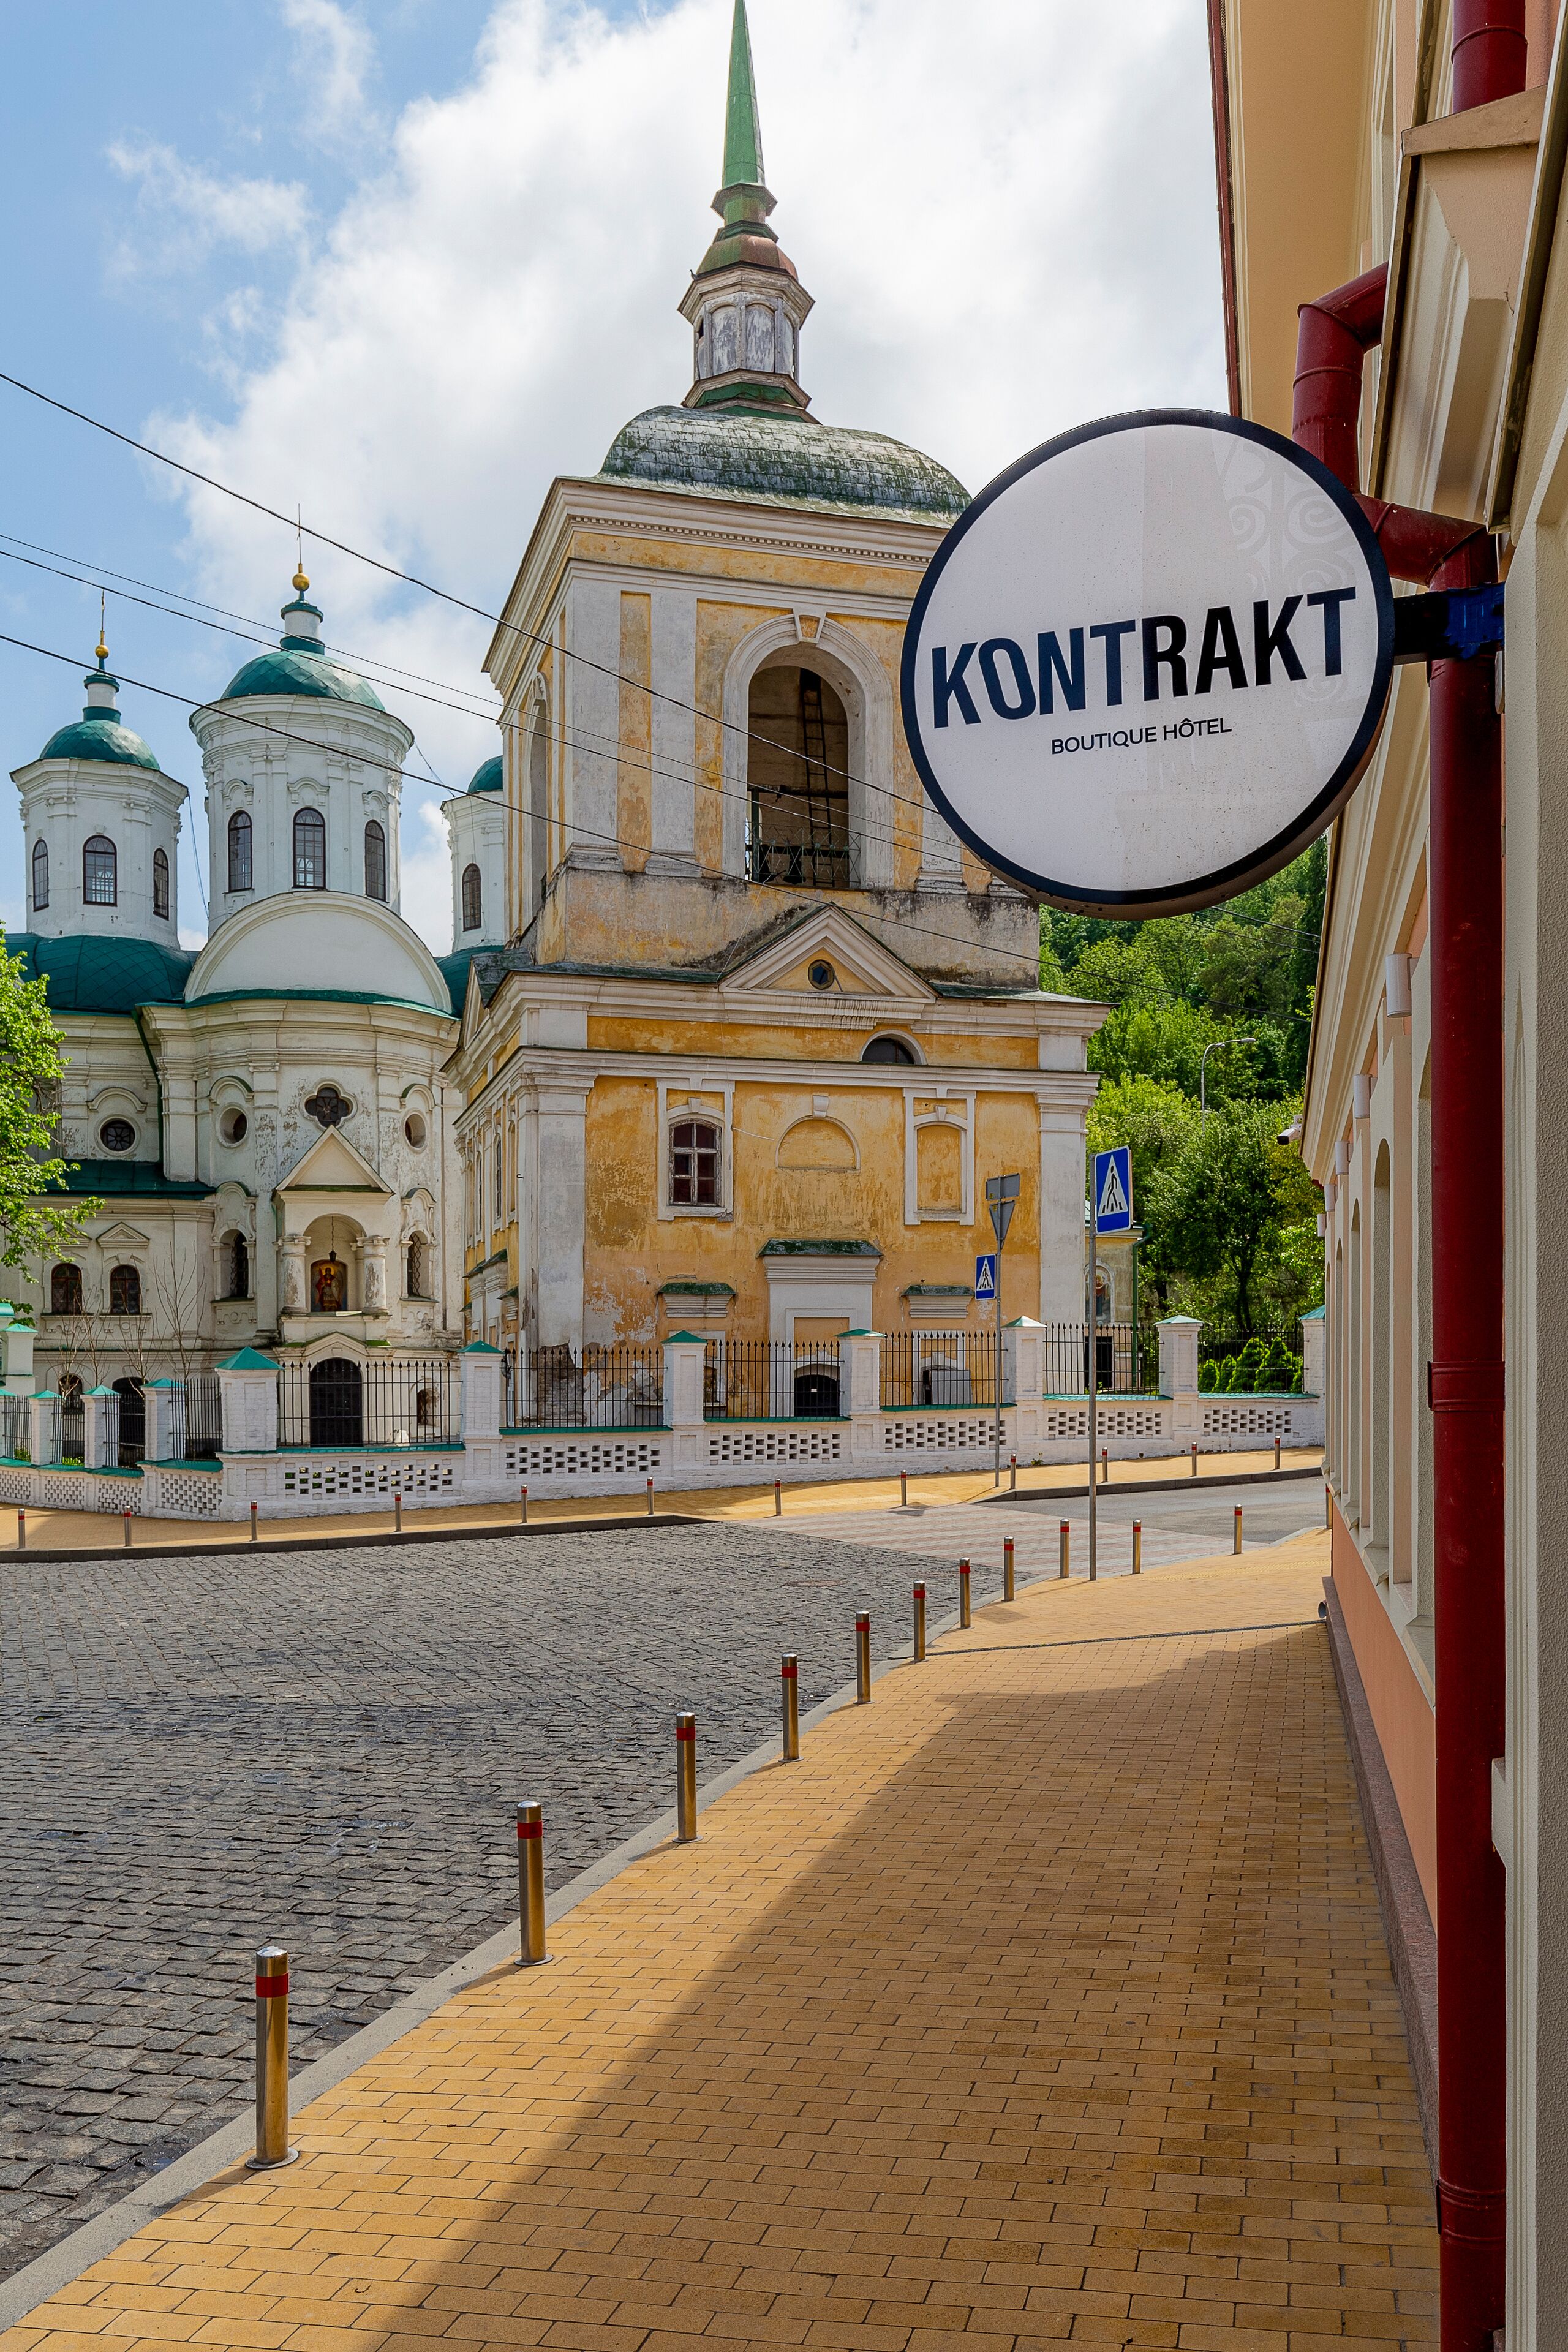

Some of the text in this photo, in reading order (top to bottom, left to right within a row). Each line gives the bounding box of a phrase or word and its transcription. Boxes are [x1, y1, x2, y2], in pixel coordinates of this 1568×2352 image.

[932, 586, 1357, 729] KONTRAKT
[1052, 717, 1232, 755] BOUTIQUE HÔTEL
